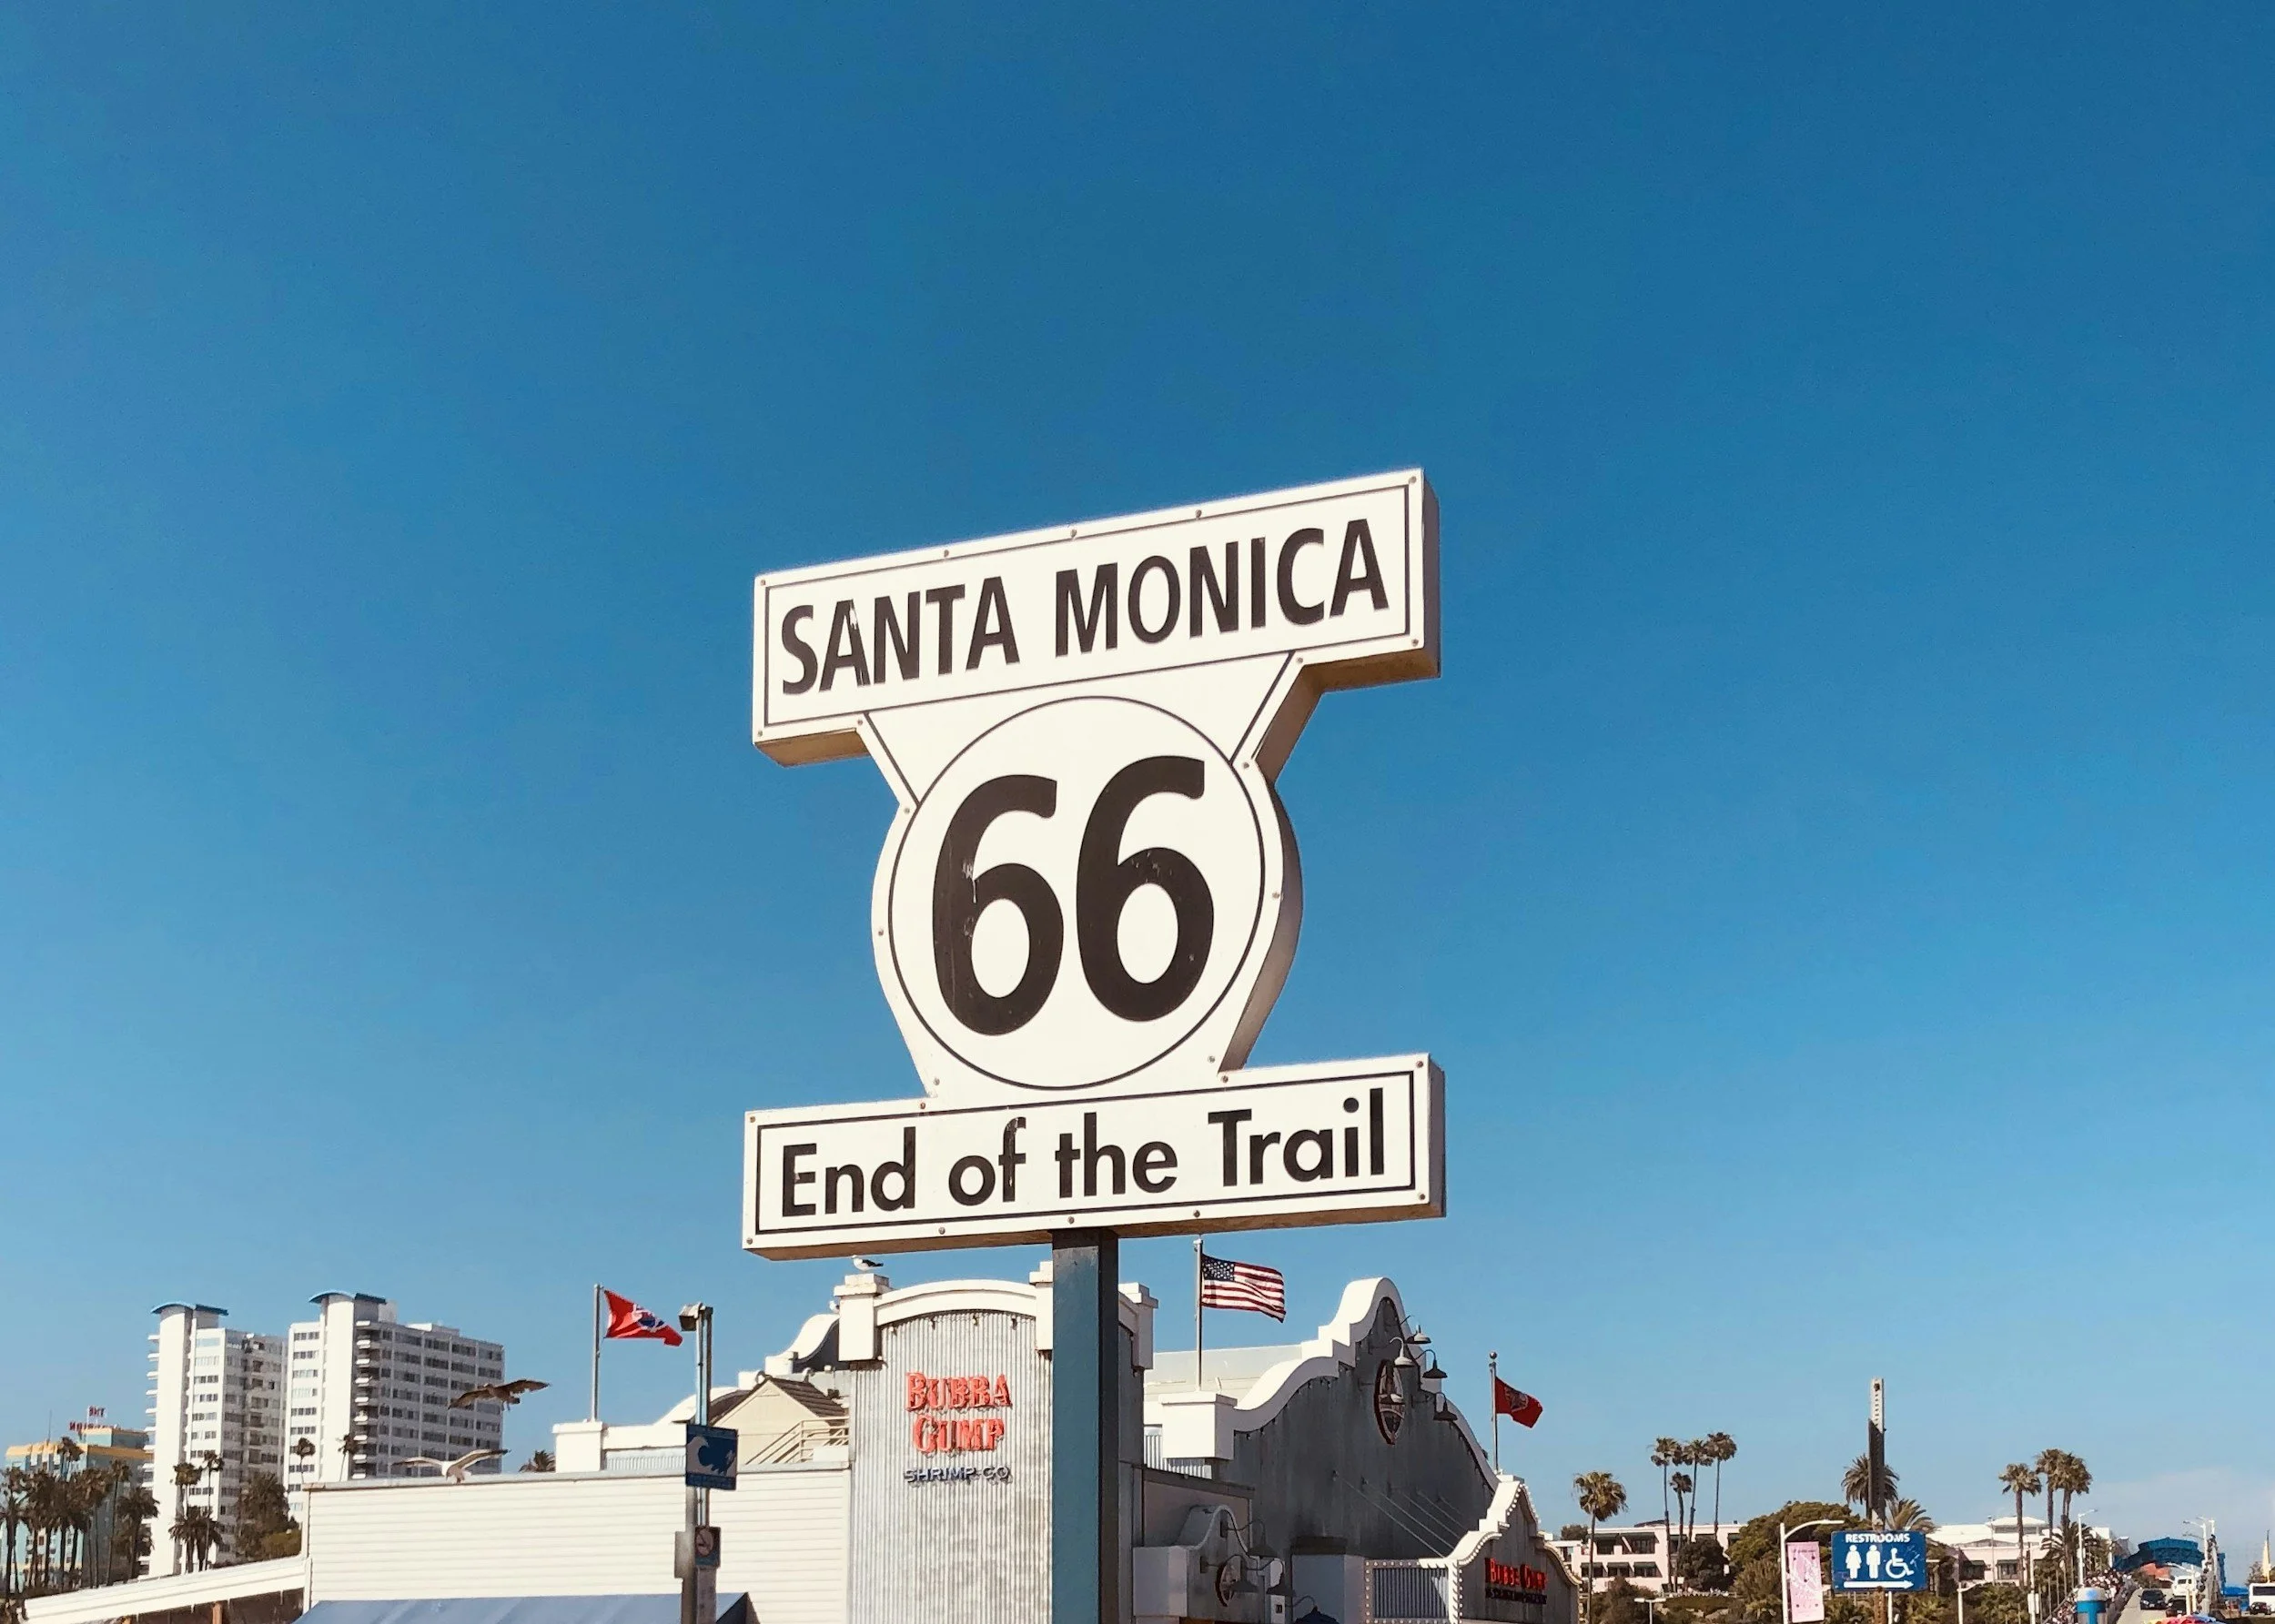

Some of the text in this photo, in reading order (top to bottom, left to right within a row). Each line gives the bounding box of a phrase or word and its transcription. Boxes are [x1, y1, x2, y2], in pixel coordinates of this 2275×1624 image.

[781, 518, 1390, 695] SANTA MONICA
[932, 755, 1215, 1036] 66
[782, 1087, 1386, 1217] End of the Trail
[905, 1372, 1012, 1411] BUBBA
[913, 1414, 1006, 1454] GUMP
[904, 1467, 976, 1484] SHRIMP
[1845, 1532, 1911, 1543] RESTROOMS
